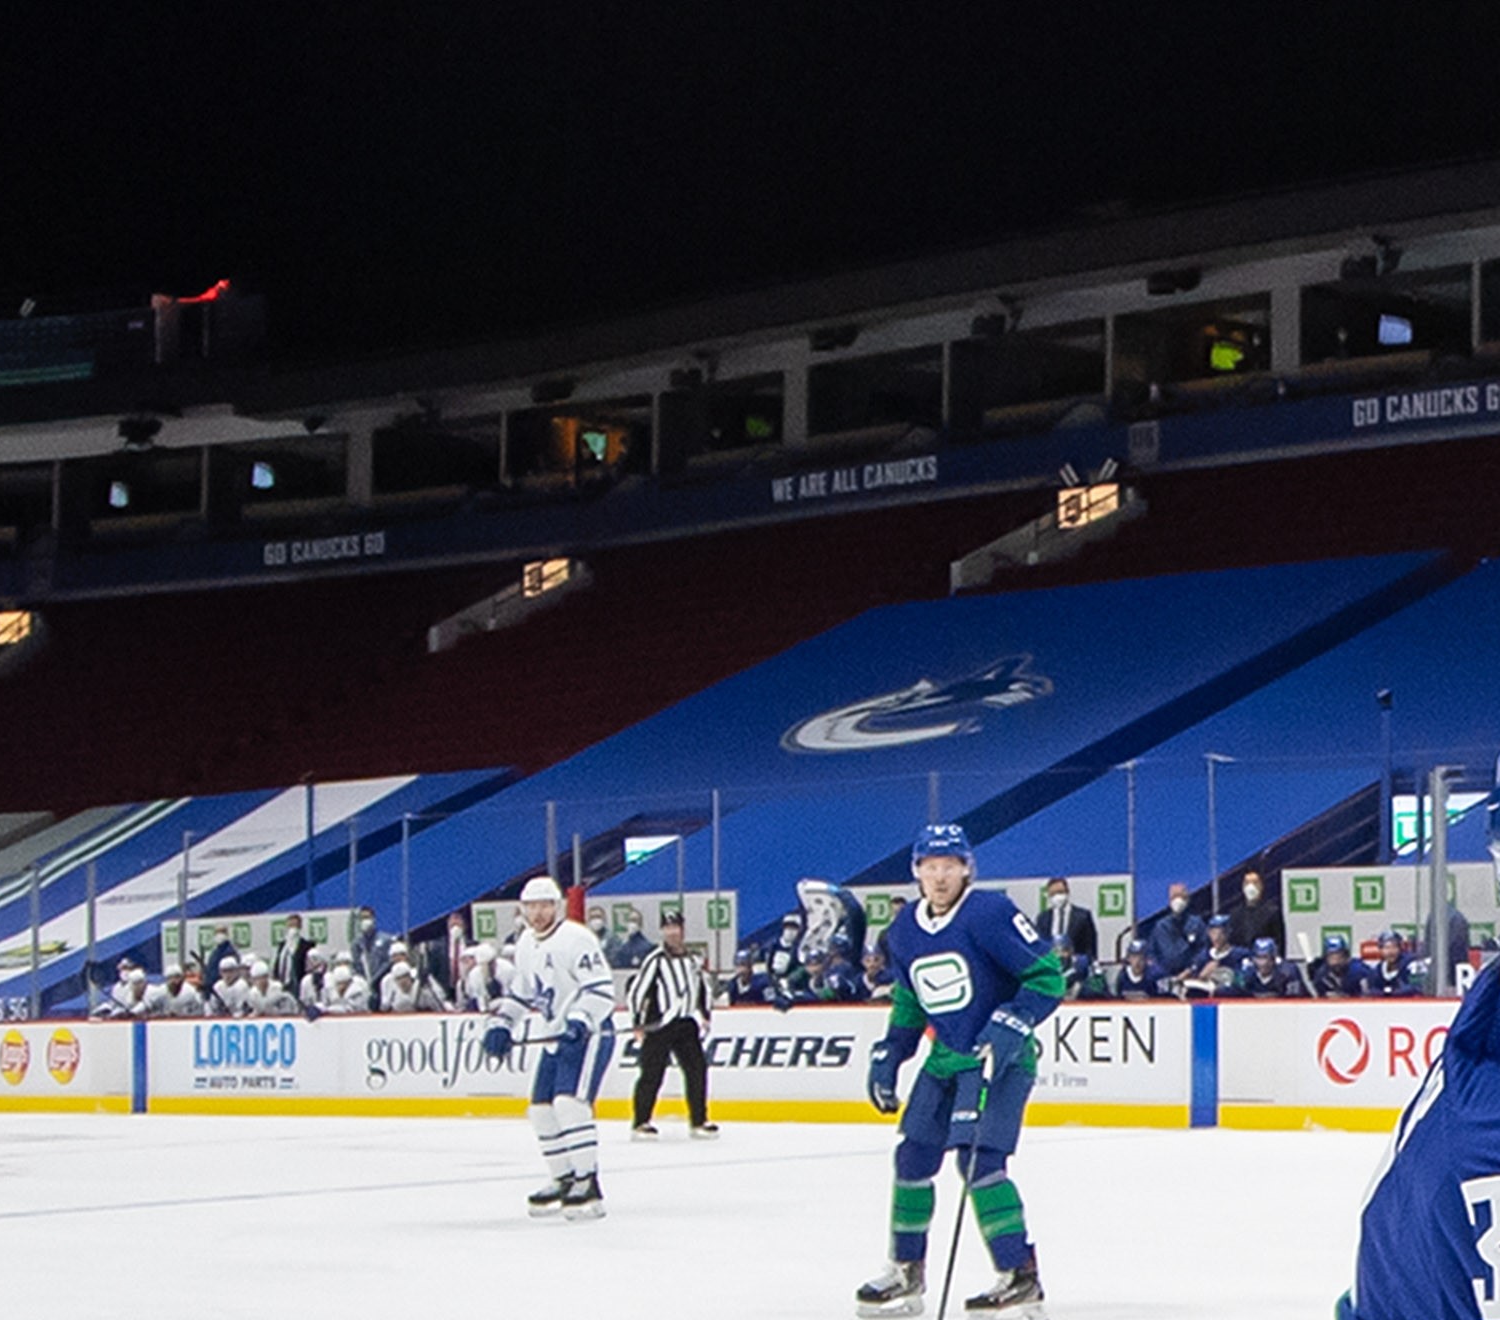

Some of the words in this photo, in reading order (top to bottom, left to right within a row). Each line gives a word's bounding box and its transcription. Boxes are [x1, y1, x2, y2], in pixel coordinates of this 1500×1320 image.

[1352, 399, 1380, 427] GO
[1385, 384, 1479, 423] CANUCKS
[771, 478, 794, 502] WE
[800, 474, 828, 499] ARE
[832, 468, 859, 493] ALL
[863, 454, 938, 490] CANUCKS
[291, 535, 361, 562] CANUCKS
[1102, 888, 1123, 911] TD
[1292, 884, 1316, 907] TD
[1357, 881, 1382, 906] TD
[869, 898, 889, 920] TD
[193, 1022, 297, 1069] LORDCO
[619, 1035, 855, 1068] SCHERS
